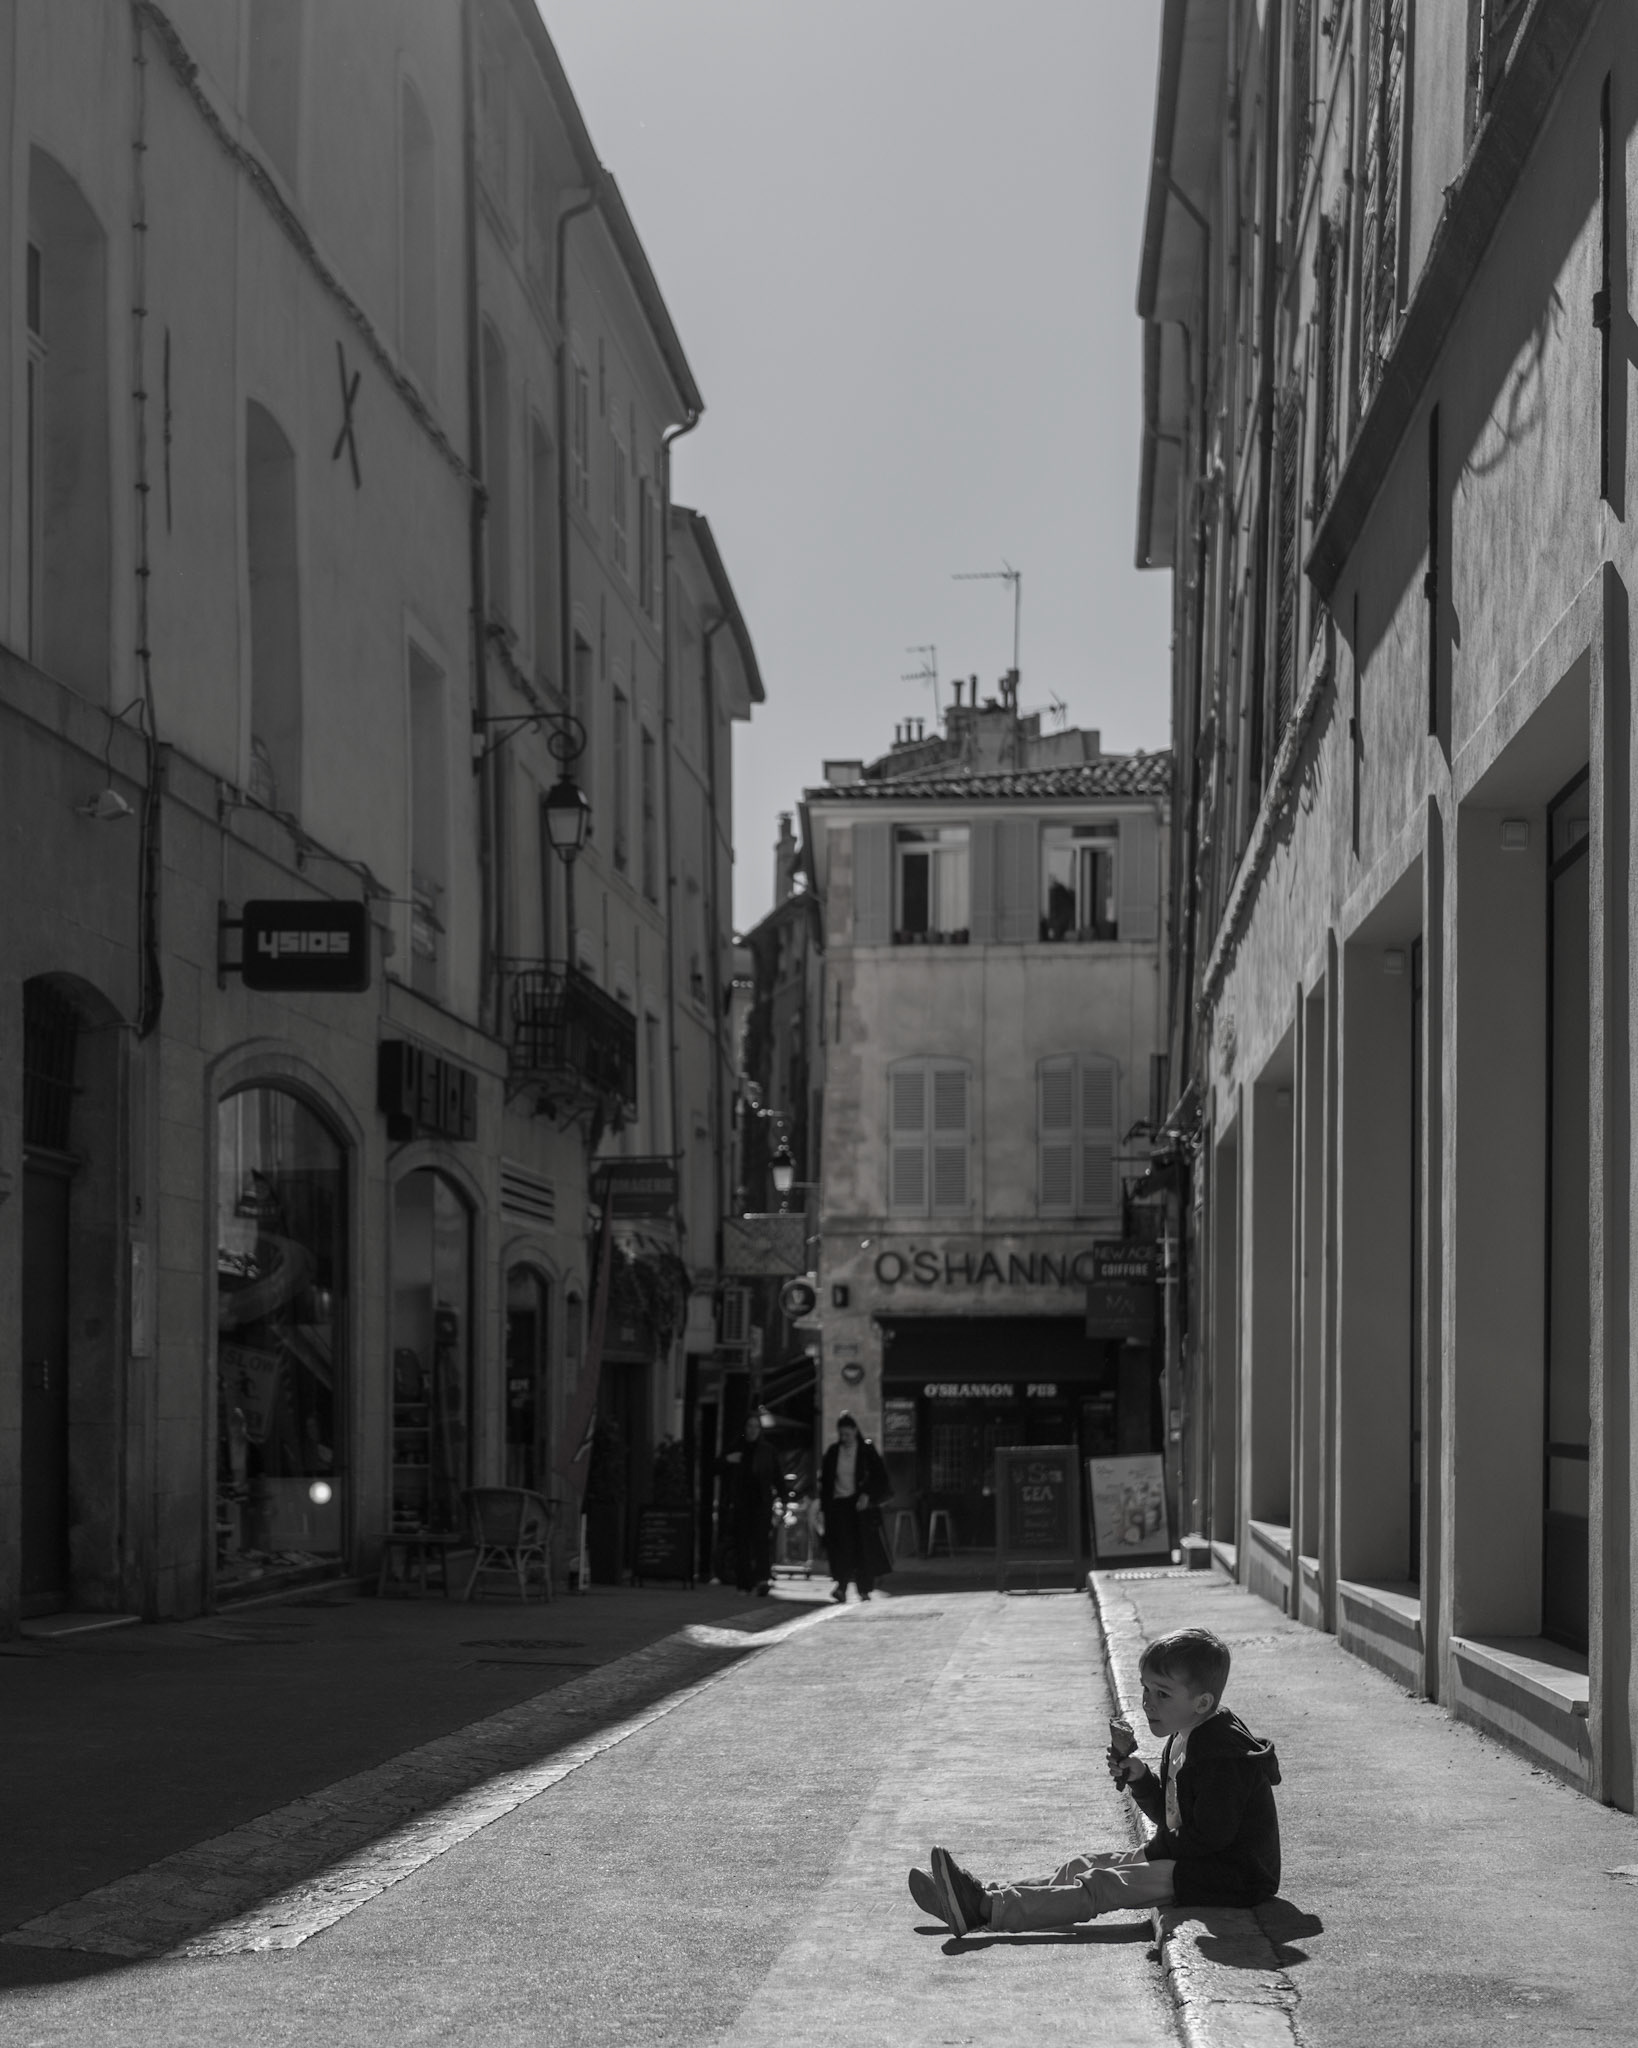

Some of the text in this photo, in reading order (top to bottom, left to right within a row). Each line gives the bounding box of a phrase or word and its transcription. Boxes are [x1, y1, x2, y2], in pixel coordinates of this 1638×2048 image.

[1101, 1263, 1149, 1277] COIFFURE
[924, 1383, 1057, 1398] O'SHANNON PUB
